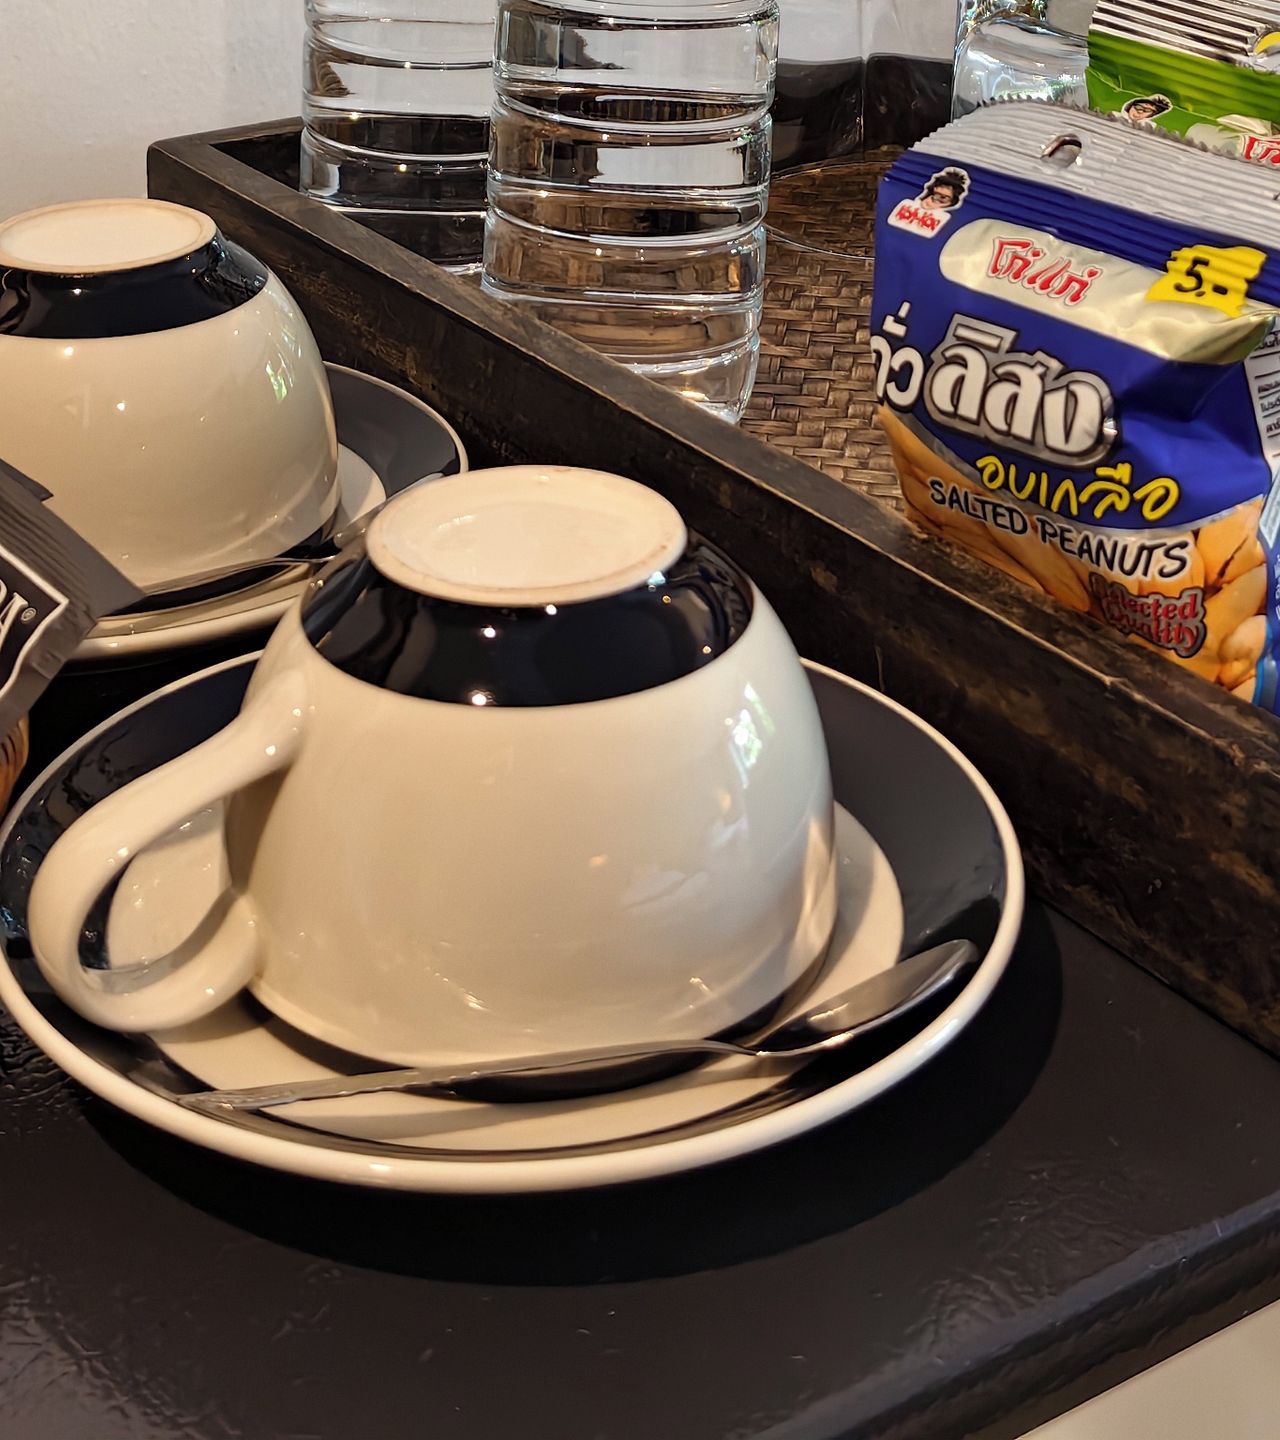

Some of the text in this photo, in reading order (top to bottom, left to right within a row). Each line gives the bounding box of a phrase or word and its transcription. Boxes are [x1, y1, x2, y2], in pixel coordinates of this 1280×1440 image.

[928, 477, 1193, 580] SALTED PEANUTS
[976, 453, 1181, 522] อบเกลือ
